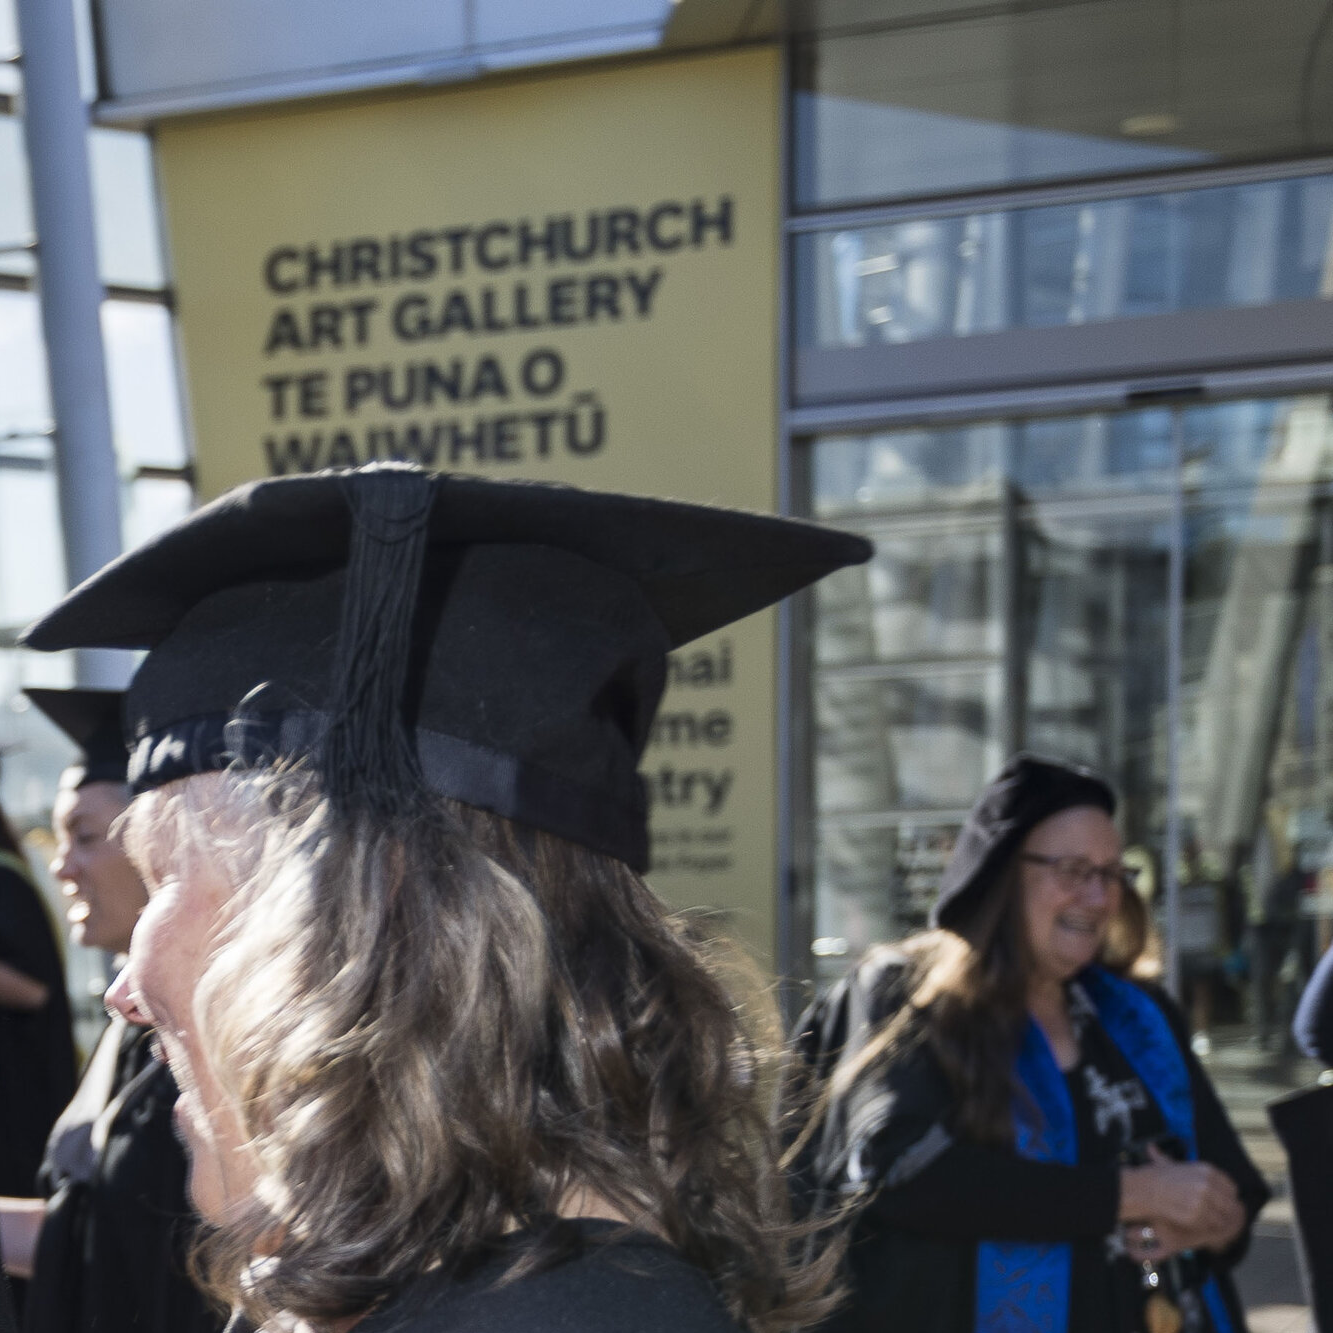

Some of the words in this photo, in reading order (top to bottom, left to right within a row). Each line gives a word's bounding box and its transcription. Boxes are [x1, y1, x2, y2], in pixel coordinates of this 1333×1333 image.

[265, 195, 735, 296] CHRISTCHURCH
[264, 298, 379, 356] ART
[393, 268, 663, 341] GALLERY
[264, 373, 327, 420] TE
[346, 355, 508, 415] PUNA
[523, 347, 564, 396] O
